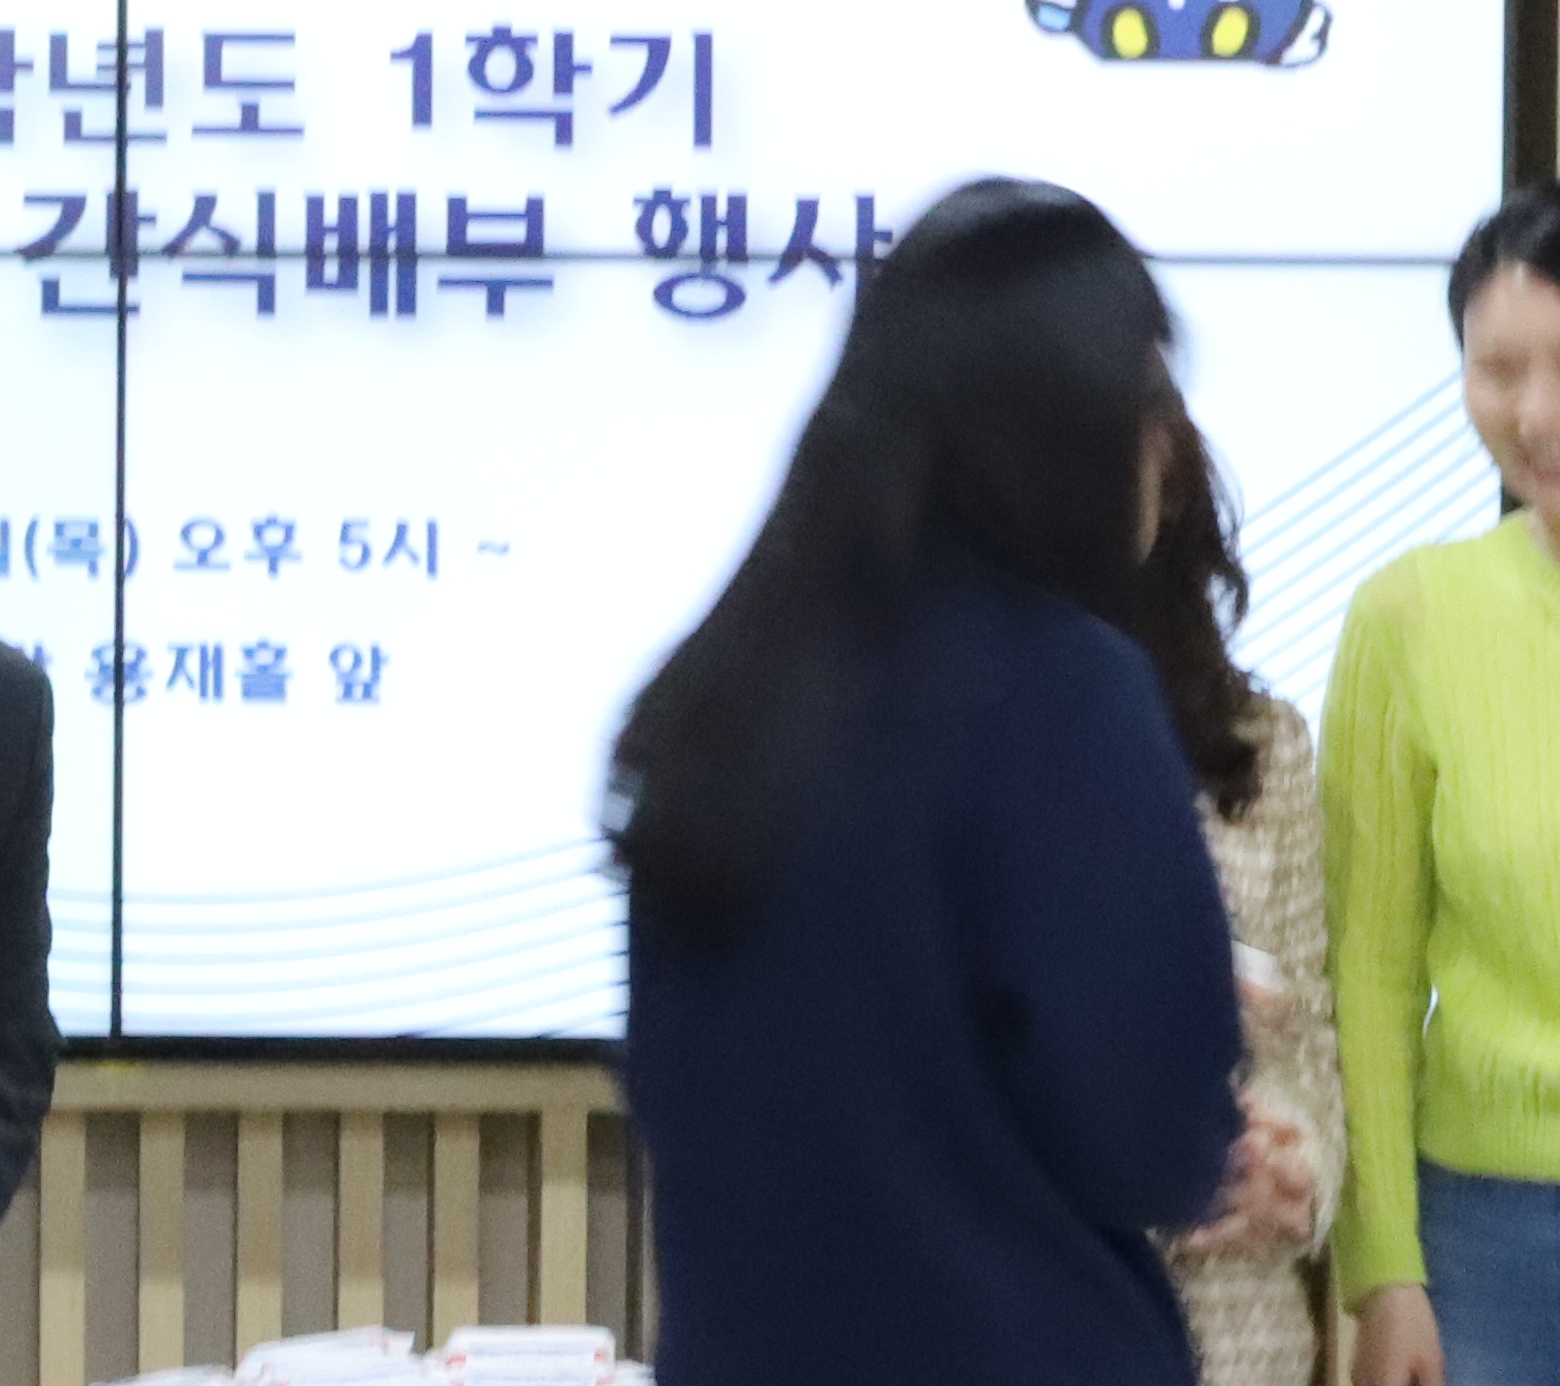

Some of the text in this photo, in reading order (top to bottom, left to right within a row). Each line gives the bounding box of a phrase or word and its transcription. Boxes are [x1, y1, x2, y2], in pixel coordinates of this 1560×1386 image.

[389, 24, 715, 150] 1학기
[16, 185, 557, 319] 간식배부
[634, 189, 893, 319] 행사
[173, 514, 302, 578] 오후
[337, 517, 440, 580] 5시
[85, 640, 292, 705] 용재홀
[327, 643, 389, 704] 앞
